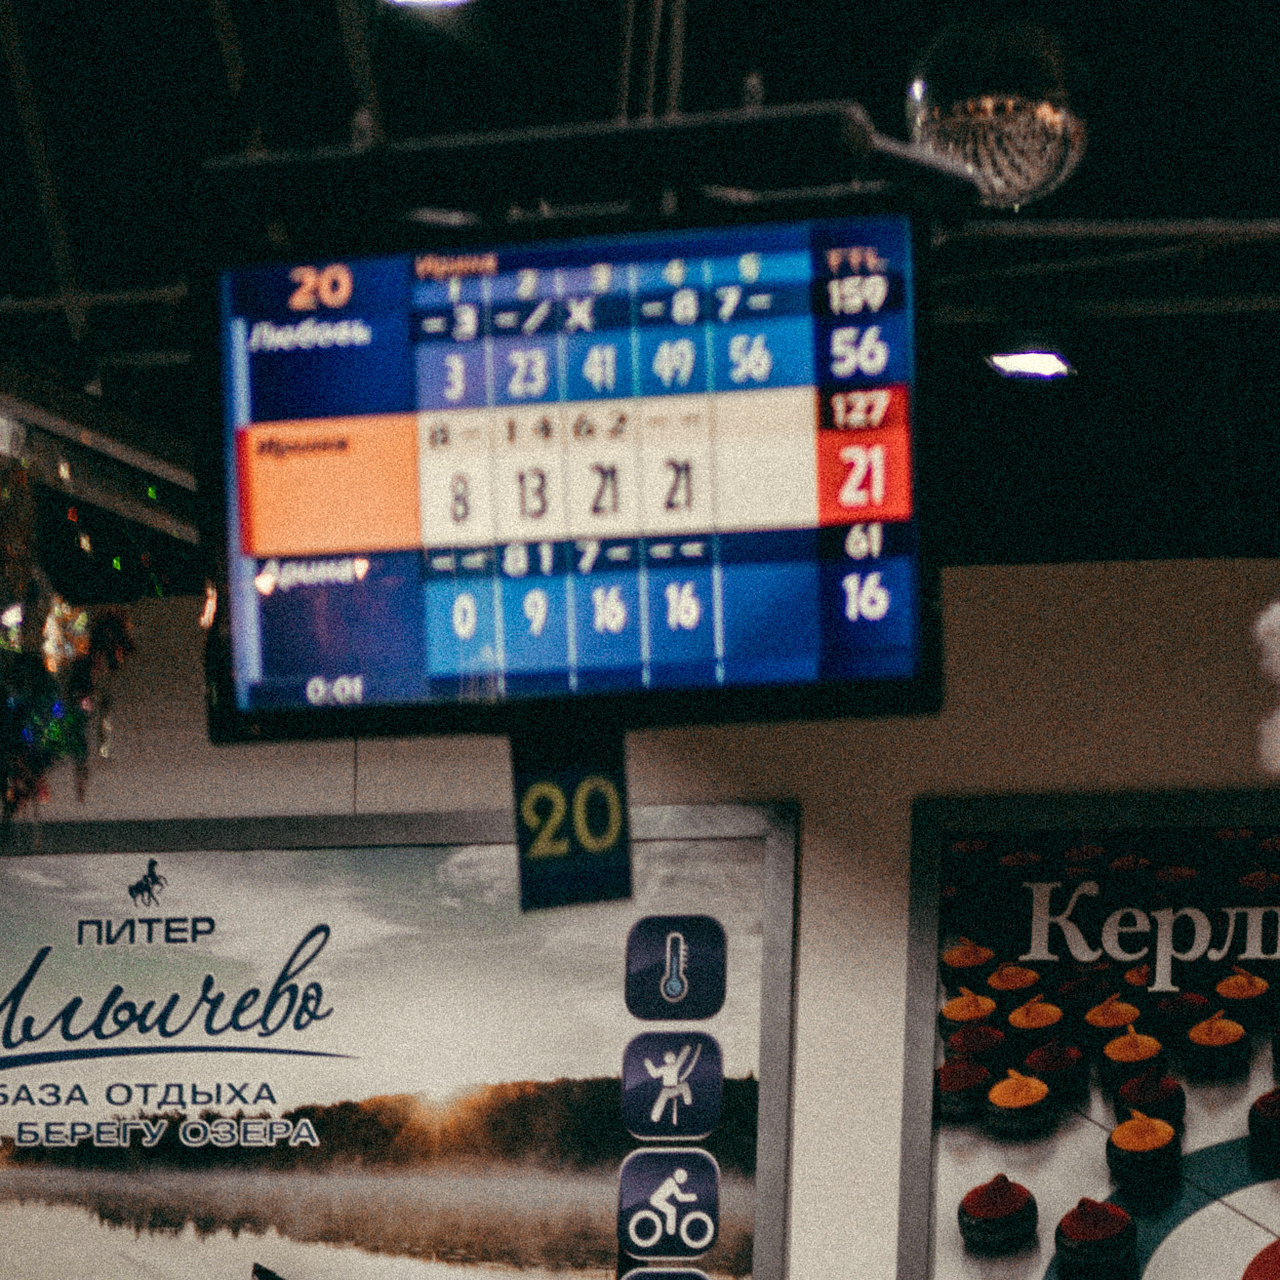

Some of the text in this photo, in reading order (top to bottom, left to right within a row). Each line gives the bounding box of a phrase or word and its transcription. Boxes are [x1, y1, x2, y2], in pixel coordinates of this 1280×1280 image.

[288, 263, 353, 312] 20
[444, 334, 774, 400] 3 23 41 49 56
[830, 325, 889, 378] 56
[452, 458, 692, 523] 8 13 21 21
[837, 444, 886, 507] 21
[452, 580, 702, 641] 0 9 16 16
[843, 572, 892, 623] 16
[521, 775, 623, 860] 20
[77, 916, 216, 946] ПИТЕР
[105, 1082, 277, 1110] ОТДЫХА
[15, 1118, 321, 1148] БЕРЕГУ ОЗЕРА
